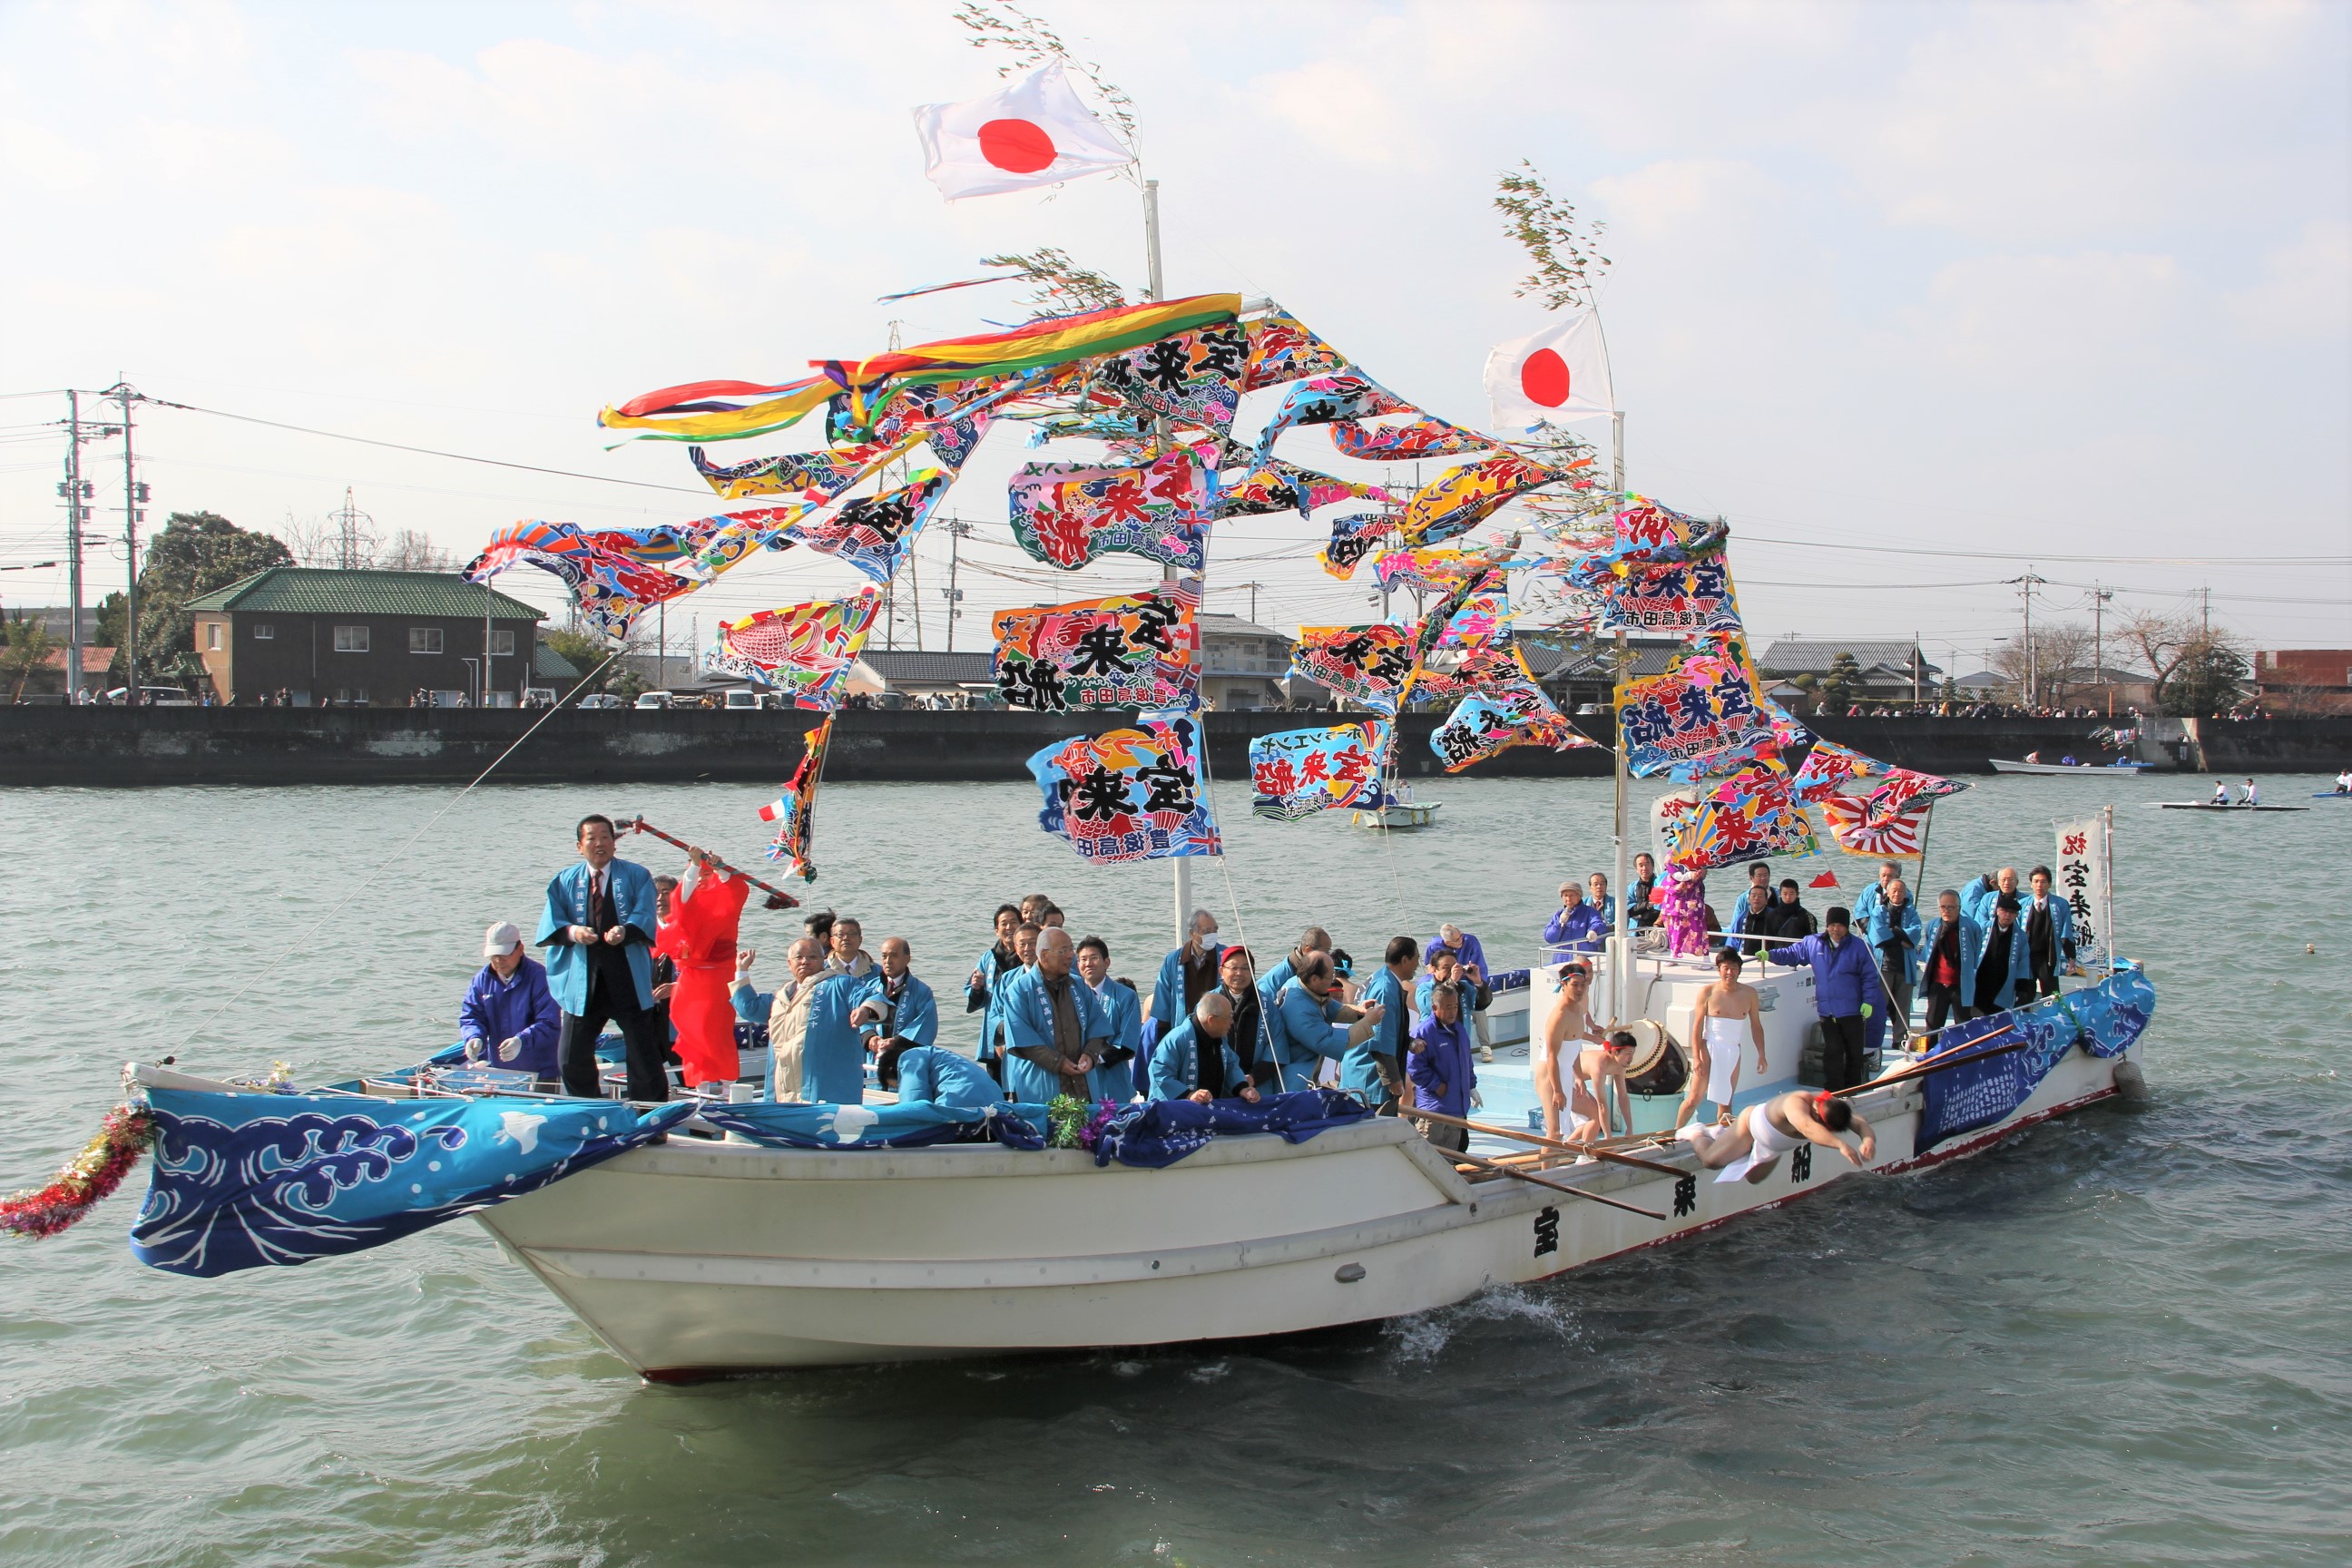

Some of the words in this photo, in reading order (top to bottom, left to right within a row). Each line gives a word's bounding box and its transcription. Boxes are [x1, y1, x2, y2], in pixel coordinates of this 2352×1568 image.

[613, 877, 628, 922] ホーランエ
